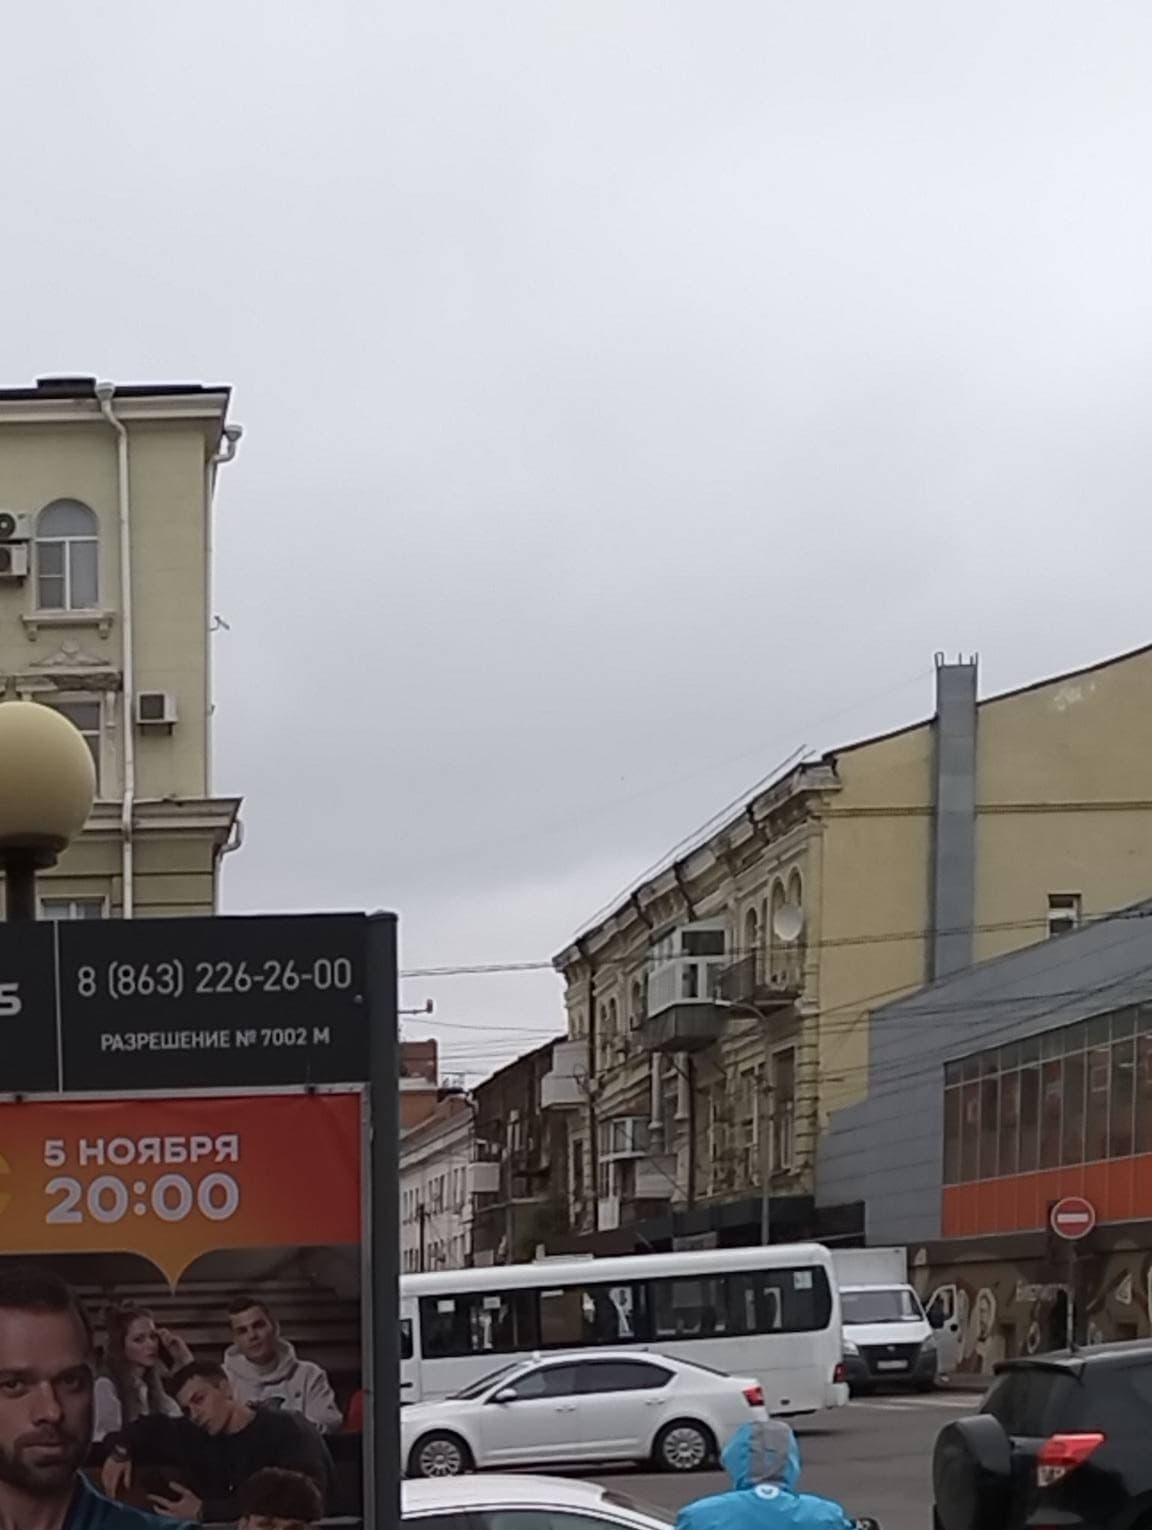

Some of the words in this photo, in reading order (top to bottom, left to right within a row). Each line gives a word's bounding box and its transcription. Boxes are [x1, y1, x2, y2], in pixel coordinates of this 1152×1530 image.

[77, 966, 96, 997] 8
[108, 958, 184, 999] (863)
[195, 958, 352, 993] 226-26-00
[101, 1030, 230, 1051] РАЗРЕШЕНИЕ
[261, 1028, 307, 1046] 7002
[44, 1139, 64, 1168] 5
[79, 1133, 240, 1166] НОЯБРЯ
[45, 1172, 241, 1225] 20:00
